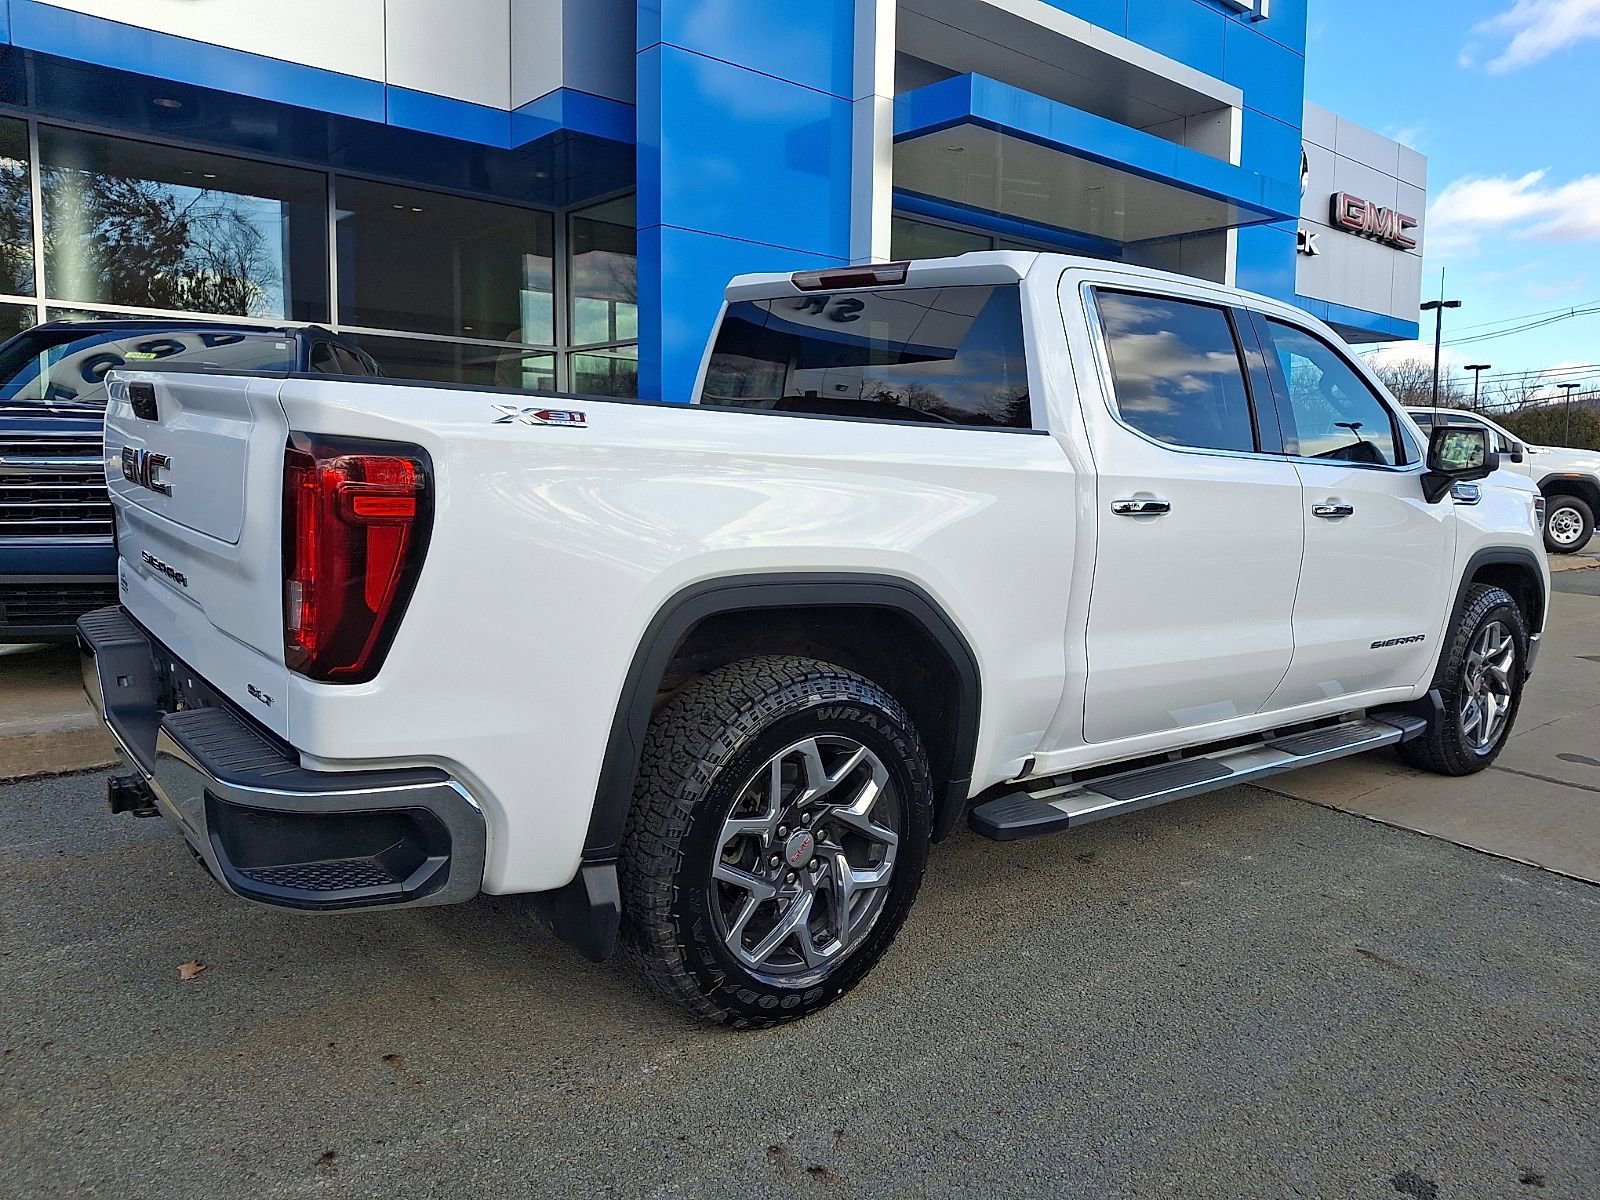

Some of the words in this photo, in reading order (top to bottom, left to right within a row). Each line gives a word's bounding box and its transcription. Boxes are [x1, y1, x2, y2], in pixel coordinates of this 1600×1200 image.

[1330, 191, 1418, 250] GMC
[122, 445, 174, 498] GMC
[141, 550, 188, 588] SIERRA
[1370, 634, 1426, 650] SIERRA
[247, 683, 275, 707] SLT
[790, 834, 811, 864] GMC
